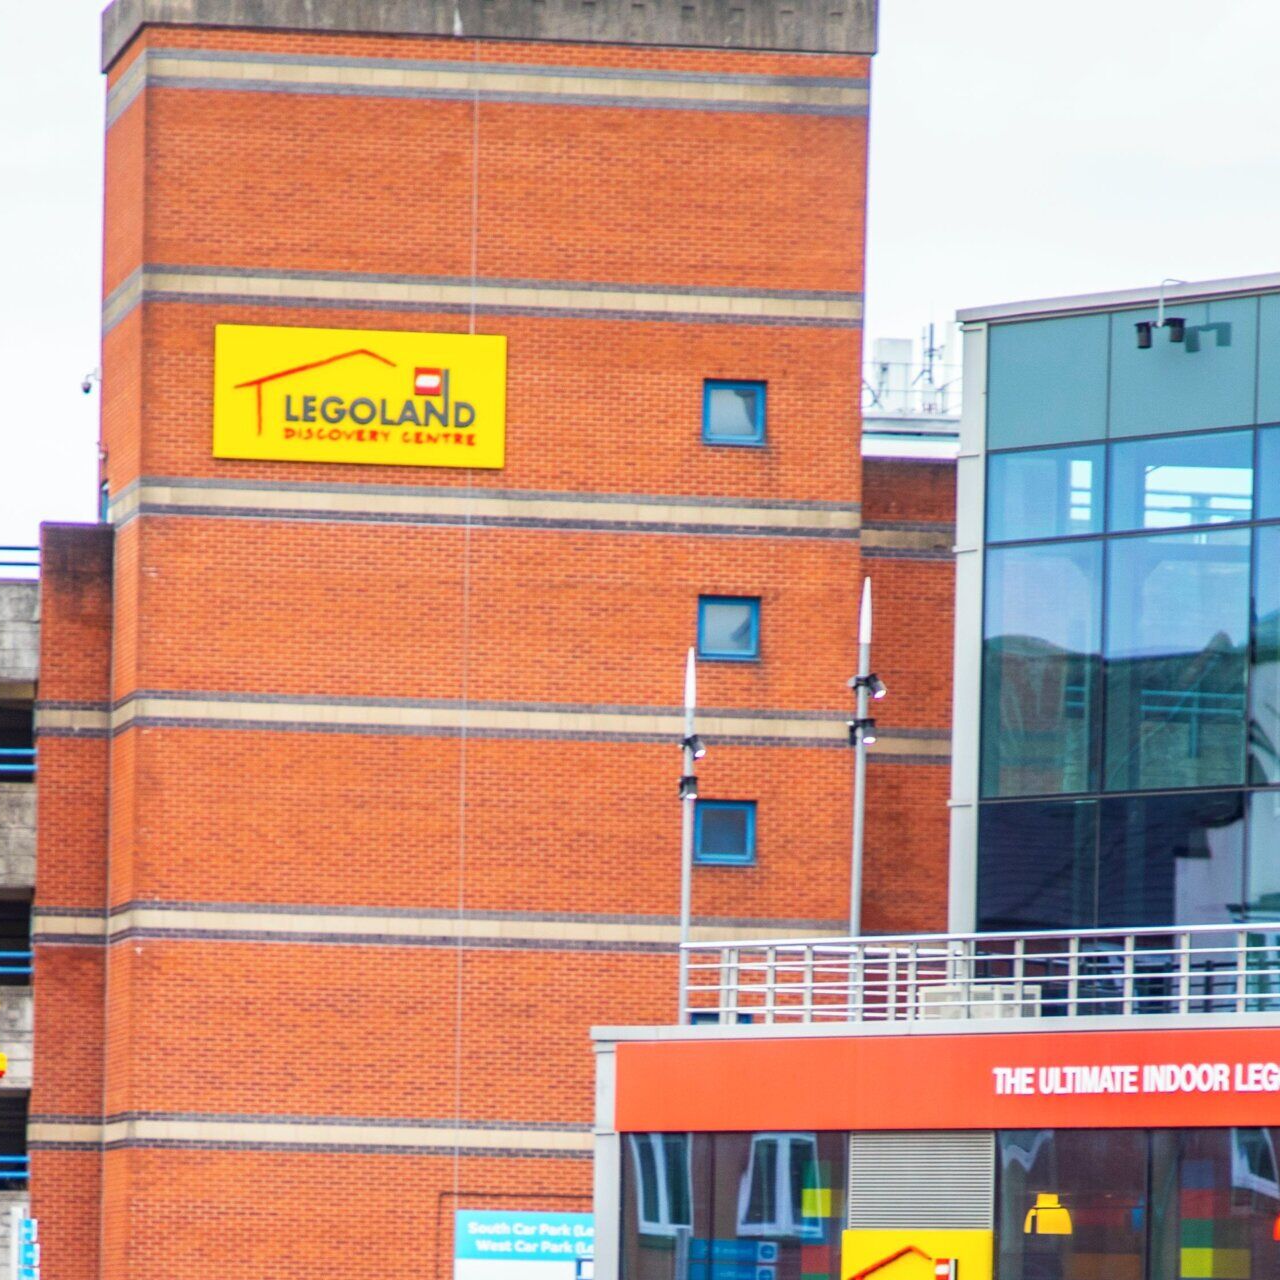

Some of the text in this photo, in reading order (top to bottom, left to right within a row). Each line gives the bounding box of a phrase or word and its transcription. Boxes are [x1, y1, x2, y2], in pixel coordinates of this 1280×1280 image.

[284, 380, 476, 428] LEGOLAND
[283, 427, 476, 446] DISCOVERY CENTRE
[992, 1067, 1035, 1095] THE
[1038, 1065, 1139, 1094] ULTIMATE
[1142, 1063, 1230, 1093] INDOOR
[467, 1221, 510, 1234] South
[512, 1222, 537, 1235] Car
[538, 1222, 571, 1236] Park
[475, 1239, 512, 1252] West
[513, 1240, 539, 1253] Car
[540, 1240, 573, 1254] Park
